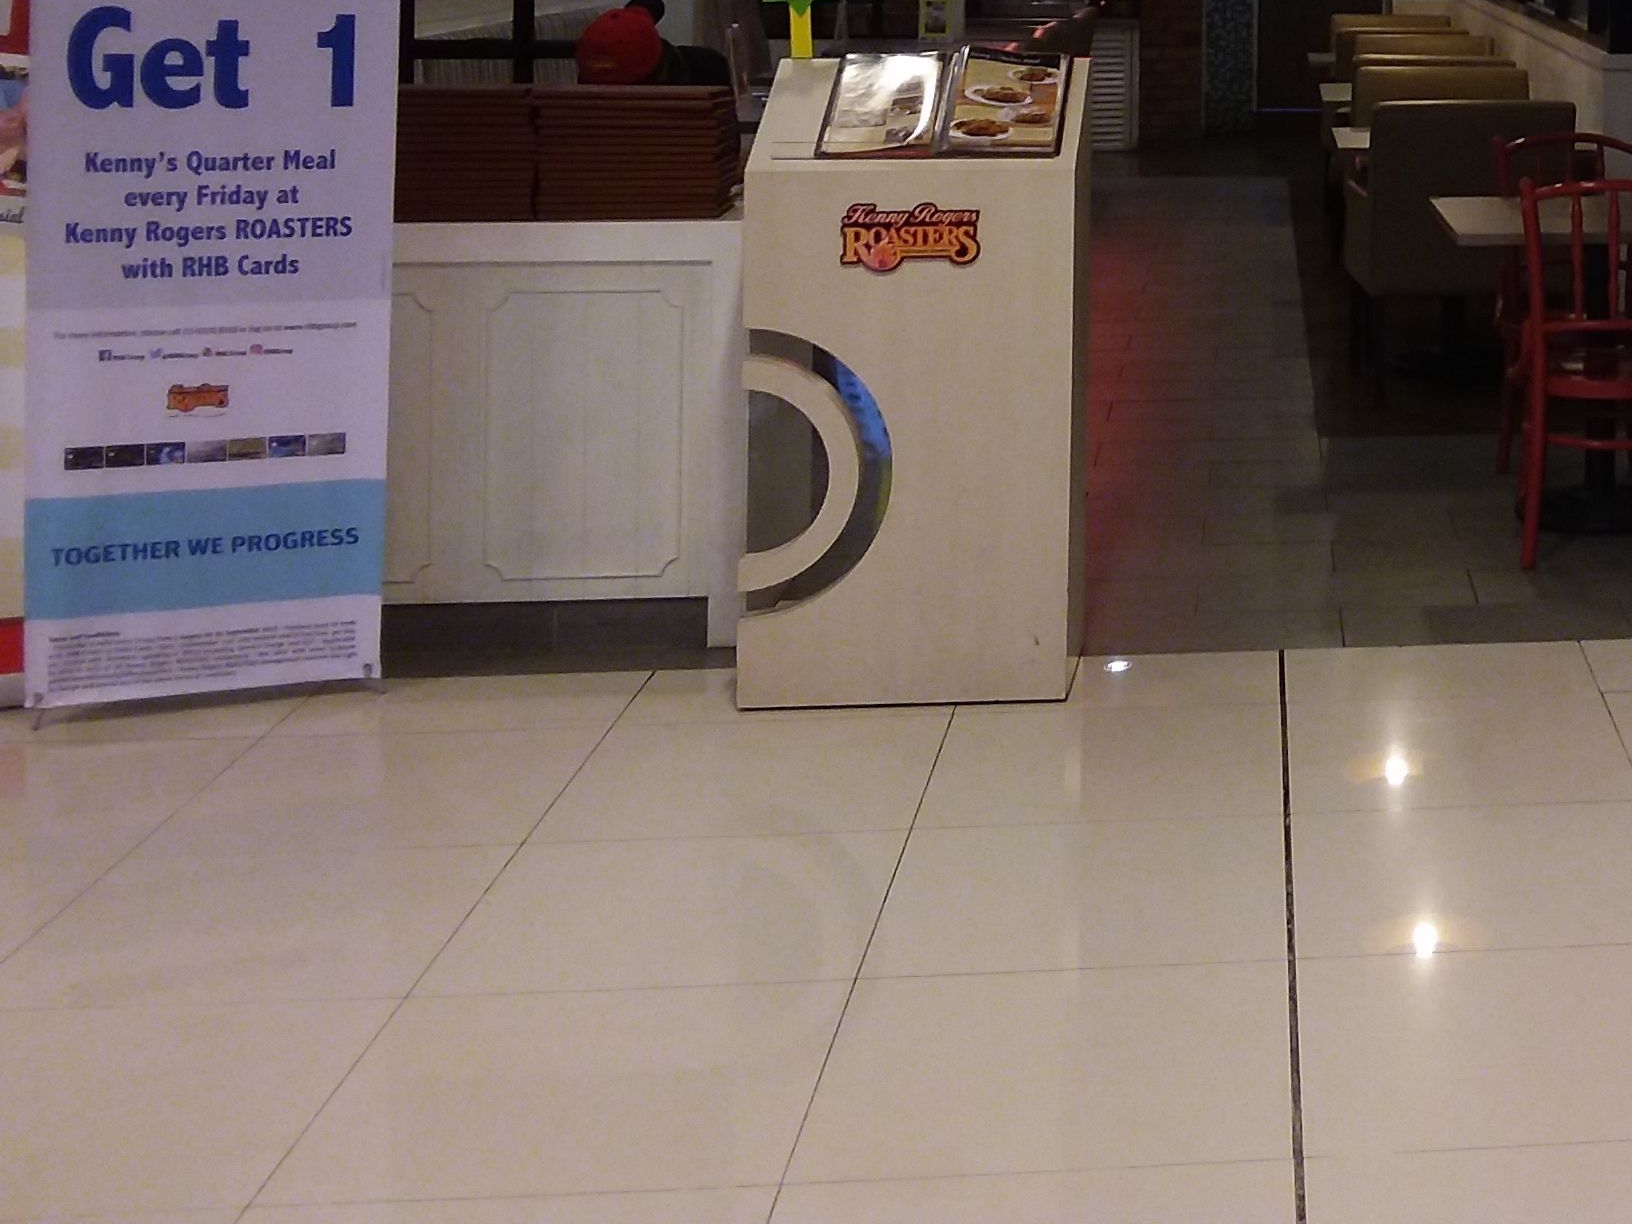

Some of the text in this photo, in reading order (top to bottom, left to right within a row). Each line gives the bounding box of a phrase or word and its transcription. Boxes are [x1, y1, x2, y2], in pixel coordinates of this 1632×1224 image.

[67, 5, 357, 110] Get 1
[84, 149, 336, 179] Kenny's Quarter Meal
[124, 184, 300, 212] every Friday at
[64, 216, 353, 249] Kenny Rogers ROASTERS
[841, 226, 980, 265] ROASTERS
[121, 253, 300, 279] with RHB Cards
[51, 526, 360, 567] TOGETHER WE PROGRESS
